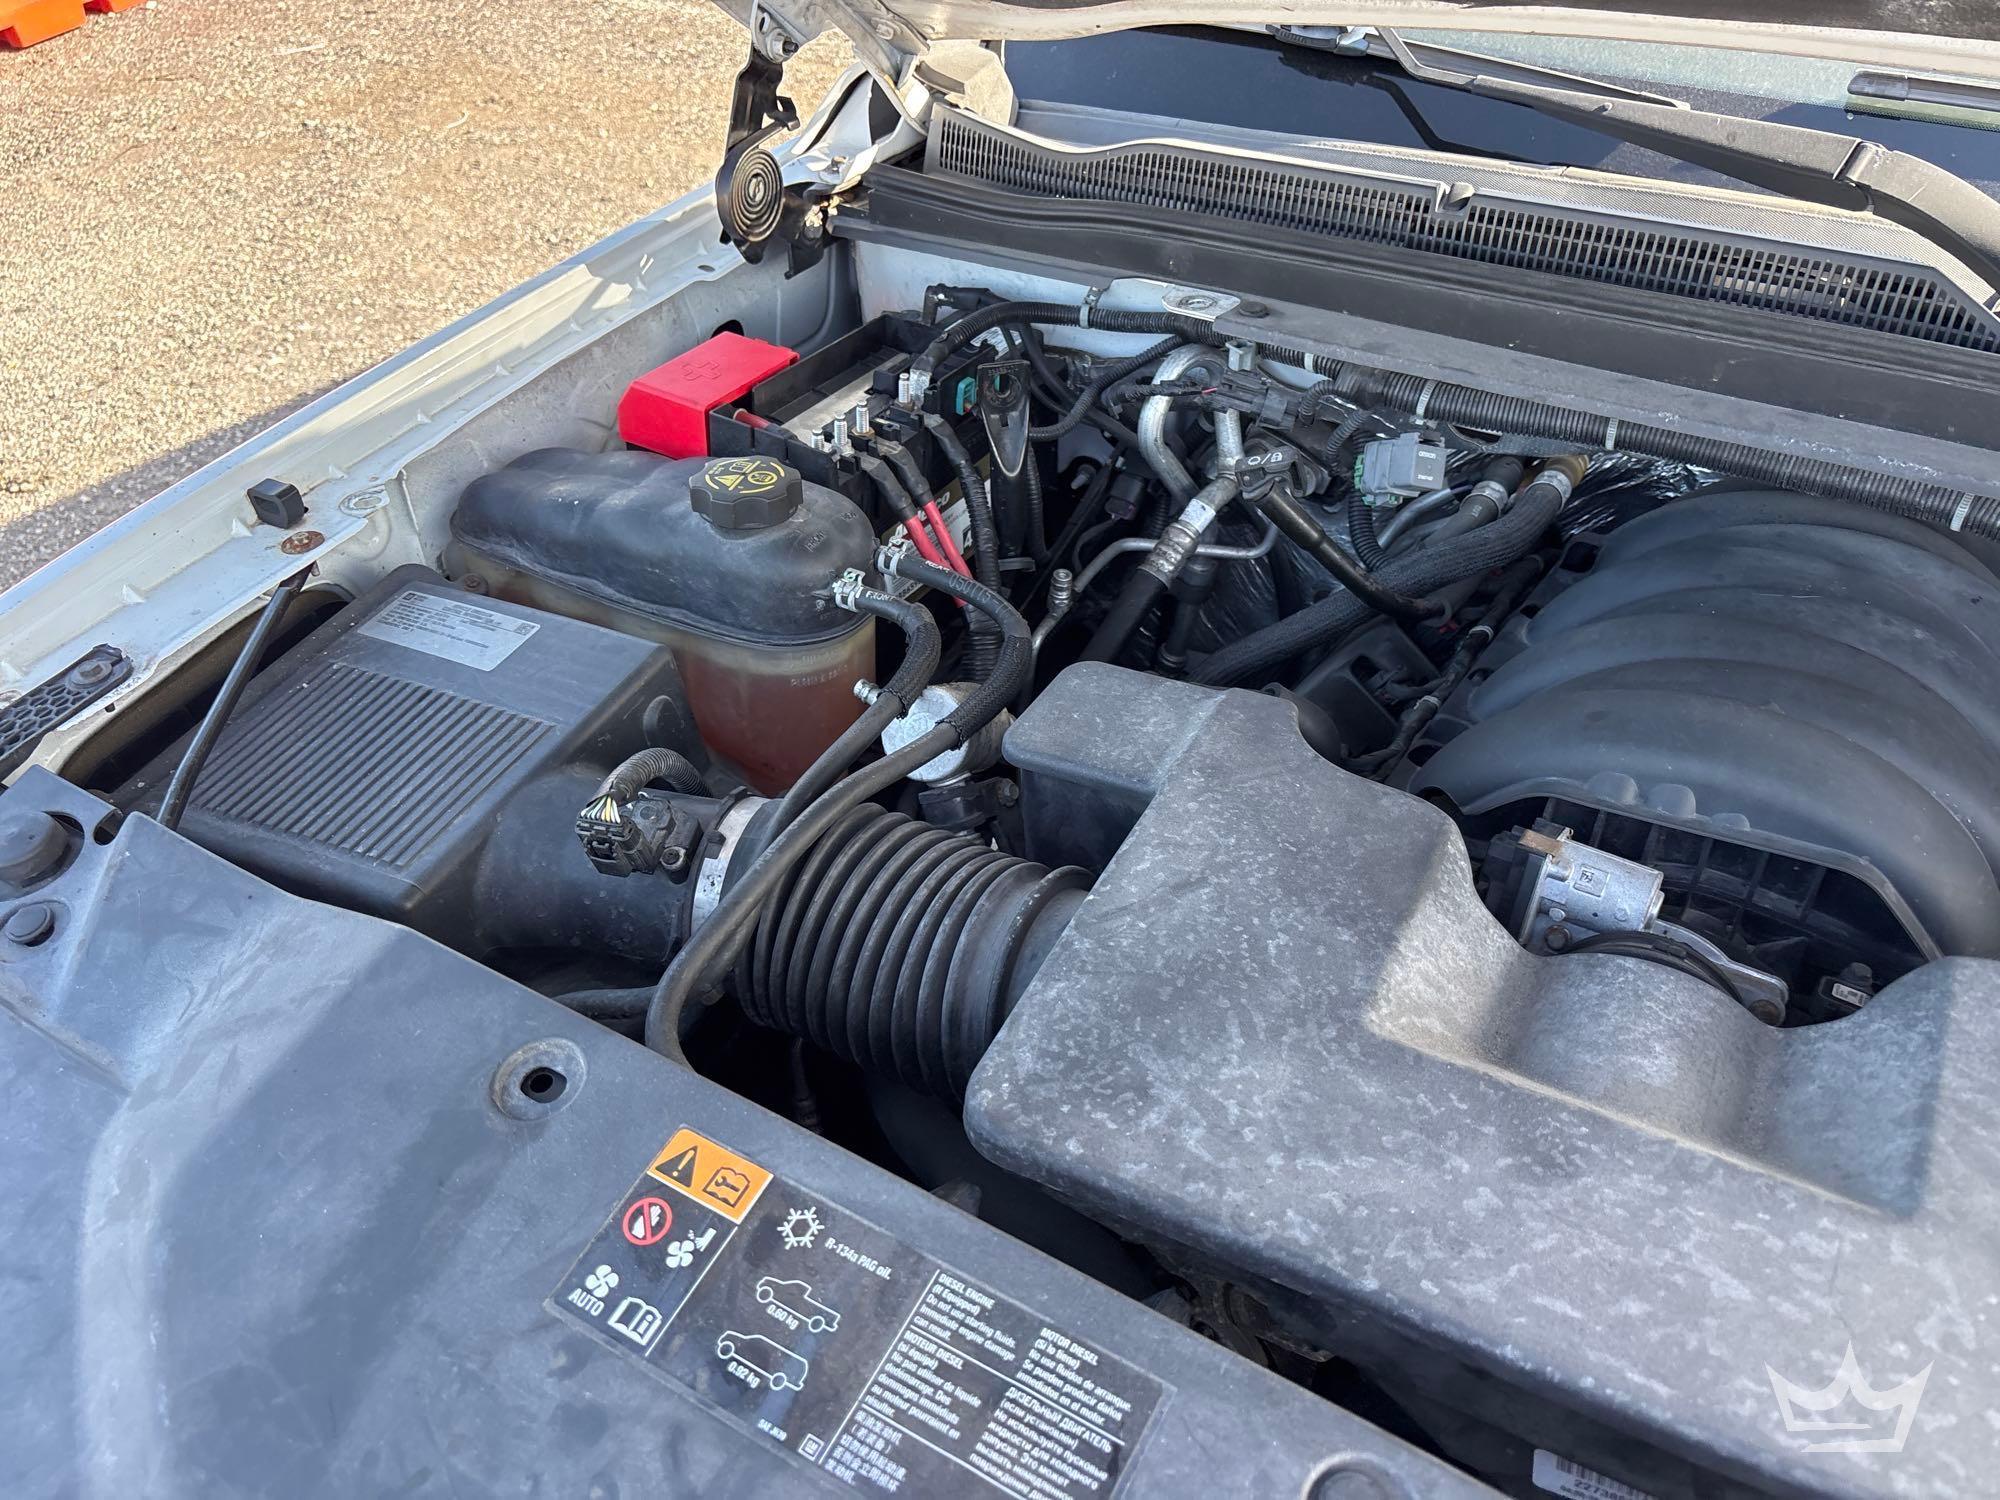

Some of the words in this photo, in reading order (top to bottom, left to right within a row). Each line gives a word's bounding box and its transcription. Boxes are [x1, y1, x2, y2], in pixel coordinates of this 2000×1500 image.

[824, 1237, 859, 1262] R-134a
[857, 1254, 878, 1272] PAG
[875, 1265, 892, 1280] oil.
[568, 1287, 605, 1317] AUTO
[938, 1273, 965, 1294] DIESEL
[964, 1287, 995, 1309] ENGINE
[941, 1288, 981, 1316] Equipped)
[766, 1304, 788, 1321] 0.60
[785, 1314, 799, 1330] kg
[913, 1315, 929, 1328] can
[927, 1323, 951, 1341] result.
[919, 1303, 959, 1330] Immediate
[958, 1326, 985, 1344] engine
[983, 1339, 1016, 1361] damage
[925, 1293, 938, 1305] Do
[937, 1300, 952, 1313] not
[950, 1308, 965, 1320] use
[964, 1315, 994, 1338] starting
[993, 1330, 1016, 1348] fluids.
[896, 1340, 910, 1353] (si
[903, 1330, 938, 1354] MOTEUR
[935, 1347, 963, 1370] DIESEL
[1034, 1338, 1048, 1350] (Si
[1045, 1343, 1056, 1355] lo
[1055, 1349, 1080, 1370] tiene)
[1040, 1327, 1071, 1349] MOTOR
[1069, 1342, 1098, 1366] DIESEL
[727, 1361, 749, 1379] 0.92
[746, 1371, 761, 1389] kg
[877, 1372, 920, 1402] dommages
[890, 1350, 903, 1363] Ne
[901, 1358, 918, 1372] pas
[916, 1367, 945, 1386] utiliser
[942, 1381, 955, 1393] de
[953, 1386, 981, 1408] liquide
[1028, 1348, 1041, 1361] No
[1040, 1356, 1056, 1369] use
[1055, 1362, 1083, 1385] fluidos
[1082, 1379, 1095, 1391] de
[934, 1389, 952, 1405] Des
[1015, 1370, 1060, 1400] inmediatos
[1058, 1395, 1071, 1406] en
[1070, 1401, 1081, 1411] el
[1022, 1358, 1034, 1371] Se
[1032, 1366, 1064, 1388] pueden
[1062, 1383, 1098, 1406] producir
[1096, 1401, 1123, 1421] daños
[870, 1384, 883, 1395] au
[881, 1390, 911, 1410] moteur
[907, 1405, 950, 1434] pourraient
[948, 1428, 960, 1439] en
[1058, 1417, 1112, 1453] ДВИГАТЕЛЬ
